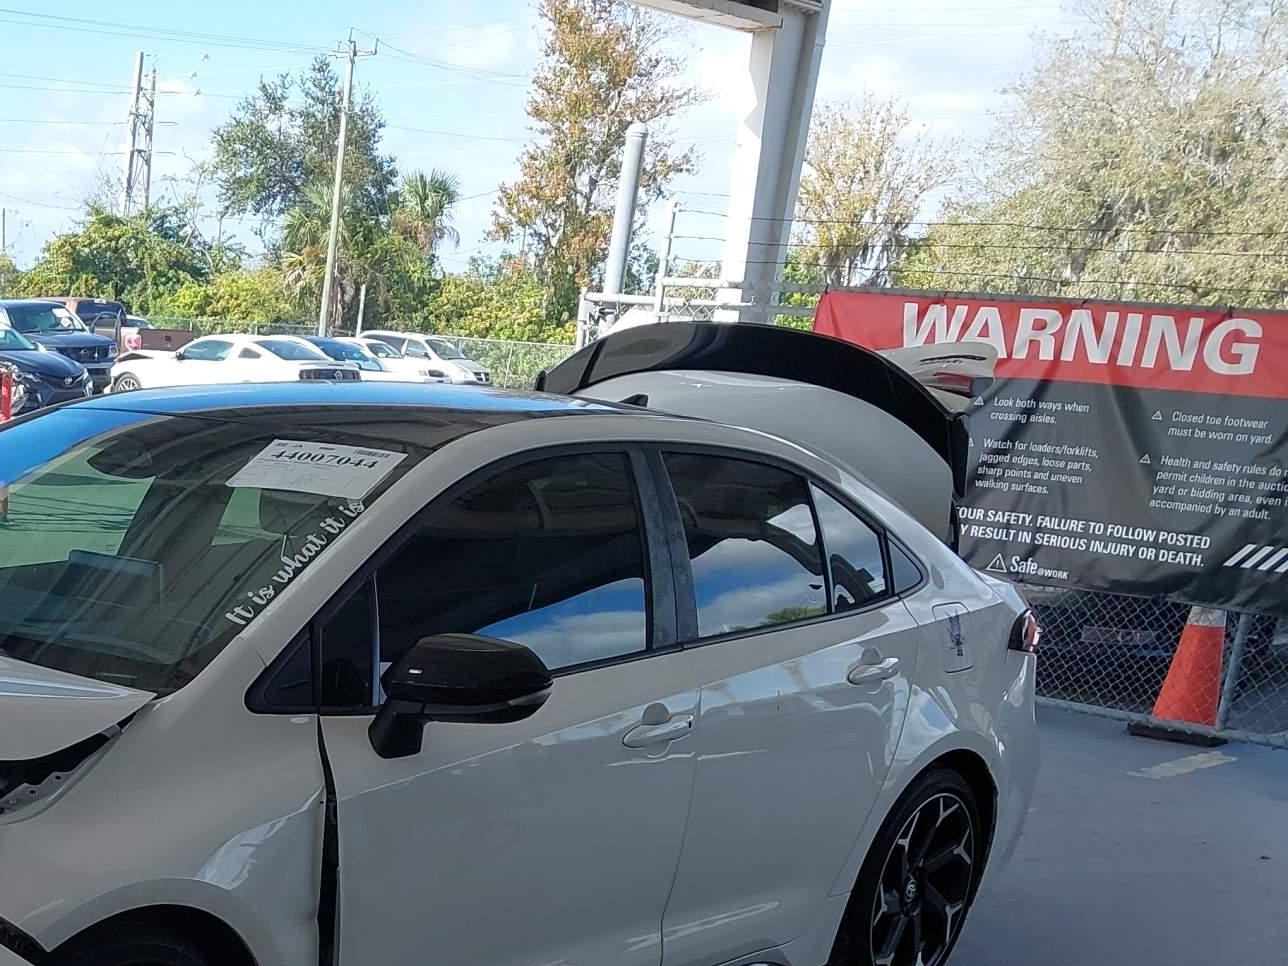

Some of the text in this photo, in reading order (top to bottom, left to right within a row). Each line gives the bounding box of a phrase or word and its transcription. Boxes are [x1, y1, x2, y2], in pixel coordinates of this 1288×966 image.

[903, 302, 1263, 376] WARNING
[994, 397, 1090, 413] Look both ways when
[990, 411, 1057, 424] crossing aisles.
[1172, 411, 1269, 429] Closed toe footwear
[1168, 426, 1273, 445] must be worn on yard.
[984, 438, 1099, 458] Watch for loaders/forklifts,
[272, 450, 378, 469] 44007044
[979, 453, 1092, 473] jagged edges, loose parts,
[1160, 455, 1191, 468] Health
[1193, 459, 1211, 470] and
[1213, 461, 1241, 474] safety
[1242, 464, 1267, 475] rules
[1269, 466, 1282, 477] do
[977, 465, 1083, 484] sharp points and uneven
[1156, 470, 1187, 482] permit
[1189, 473, 1225, 486] children
[1227, 477, 1236, 487] in
[1239, 478, 1255, 489] the
[975, 479, 1049, 494] walking surfaces.
[1153, 484, 1175, 495] yard
[1178, 487, 1188, 496] or
[1190, 487, 1225, 502] bidding
[1228, 493, 1253, 505] area,
[1256, 496, 1281, 506] even
[1149, 498, 1271, 520] accompanied by an adult.
[959, 506, 1211, 549] OUR SAFETY. FAILURE TO FOLLOW POSTED
[970, 525, 1016, 541] RESULT
[1018, 531, 1032, 543] IN
[1035, 532, 1088, 551] SERIOUS
[1089, 540, 1136, 557] INJURY
[1138, 546, 1156, 561] OR
[1158, 549, 1205, 567] DEATH.
[225, 500, 365, 625] It is what it is
